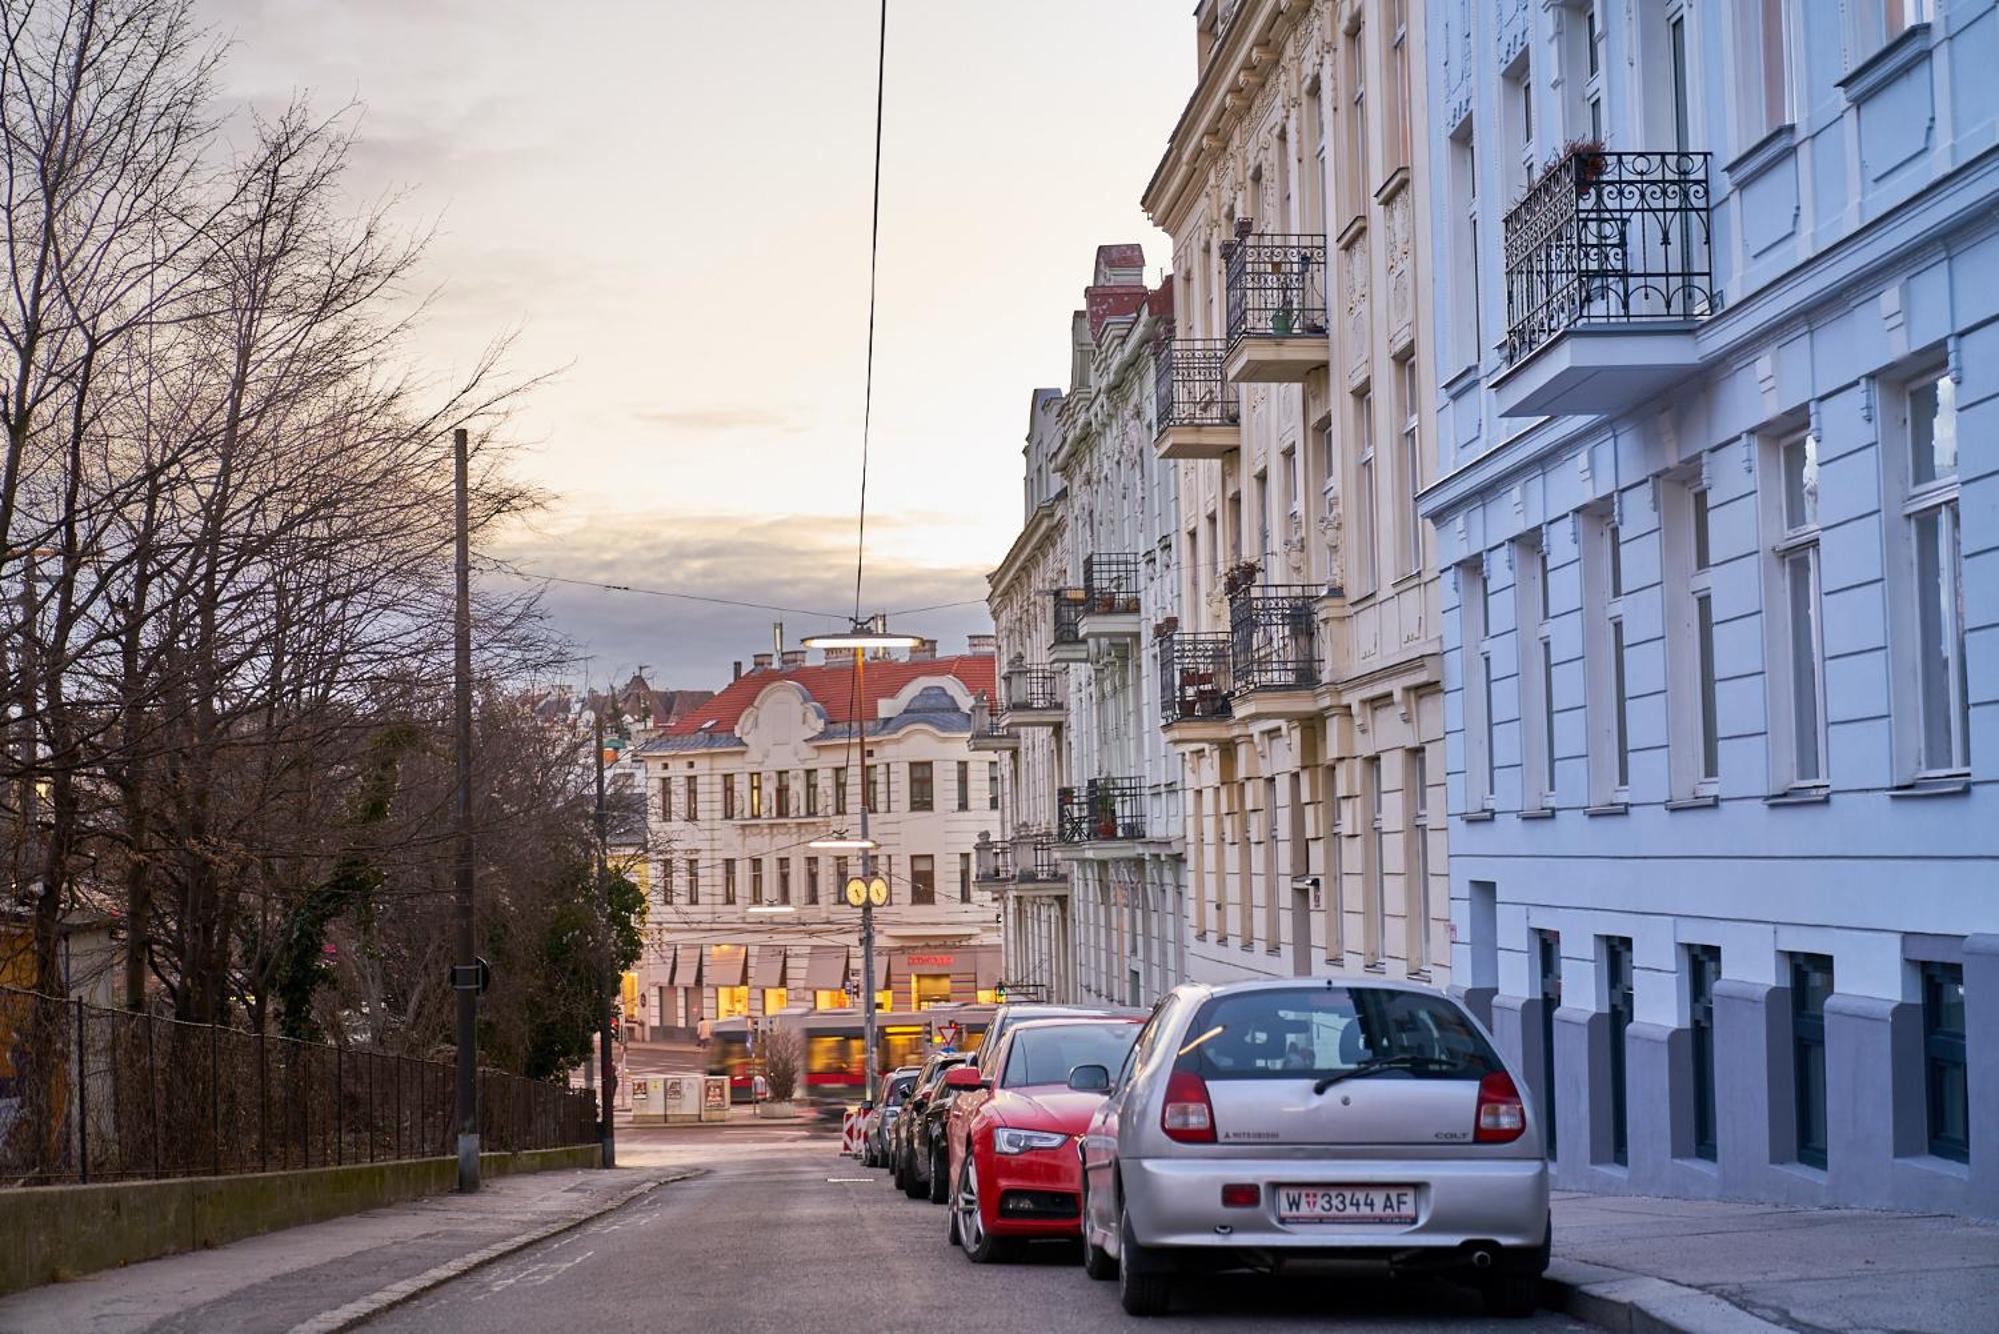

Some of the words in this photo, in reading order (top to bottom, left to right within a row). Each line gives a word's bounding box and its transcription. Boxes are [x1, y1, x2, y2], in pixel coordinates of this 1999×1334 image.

[1434, 1131, 1470, 1139] COLT
[1286, 1191, 1302, 1213] W
[1320, 1191, 1375, 1213] 3344
[1382, 1191, 1409, 1213] AF
